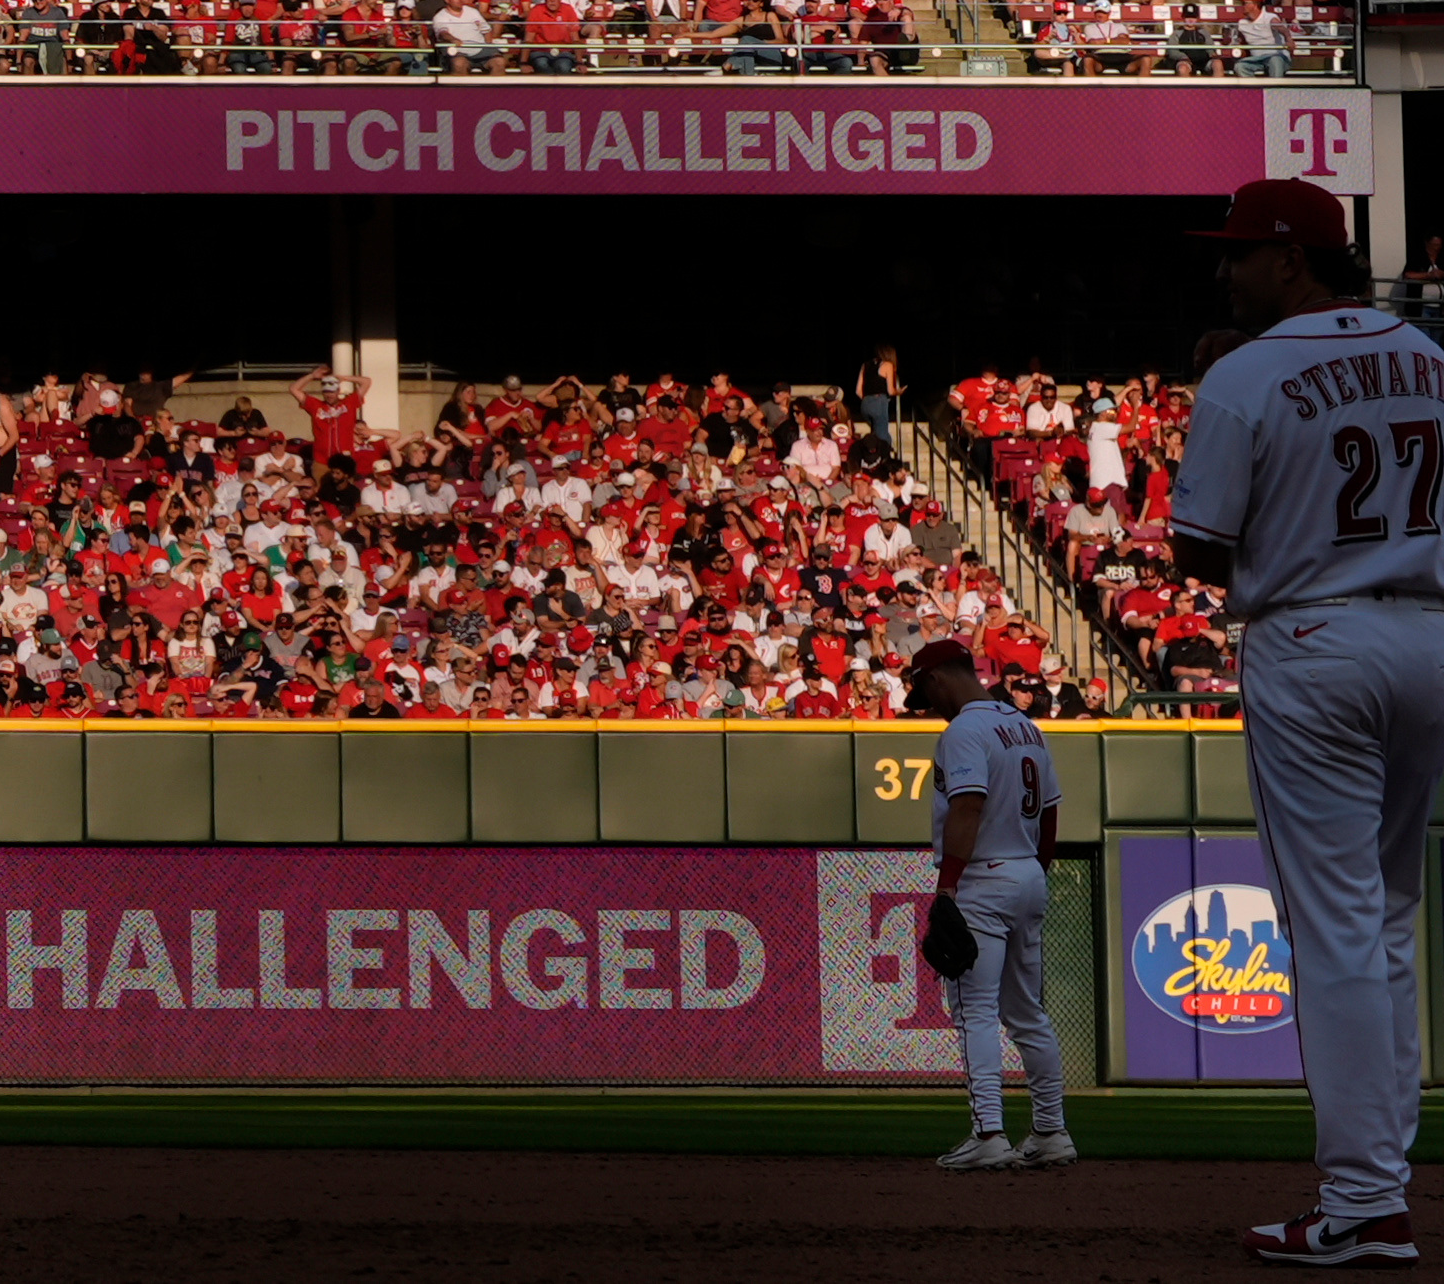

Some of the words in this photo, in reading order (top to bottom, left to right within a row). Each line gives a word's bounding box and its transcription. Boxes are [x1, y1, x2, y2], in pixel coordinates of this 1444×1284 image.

[226, 110, 454, 172] PITCH
[474, 109, 994, 173] CHALLENGED
[1333, 416, 1441, 547] 27
[1105, 565, 1135, 579] REDS
[1021, 757, 1041, 819] 9
[1191, 997, 1274, 1012] CHILI
